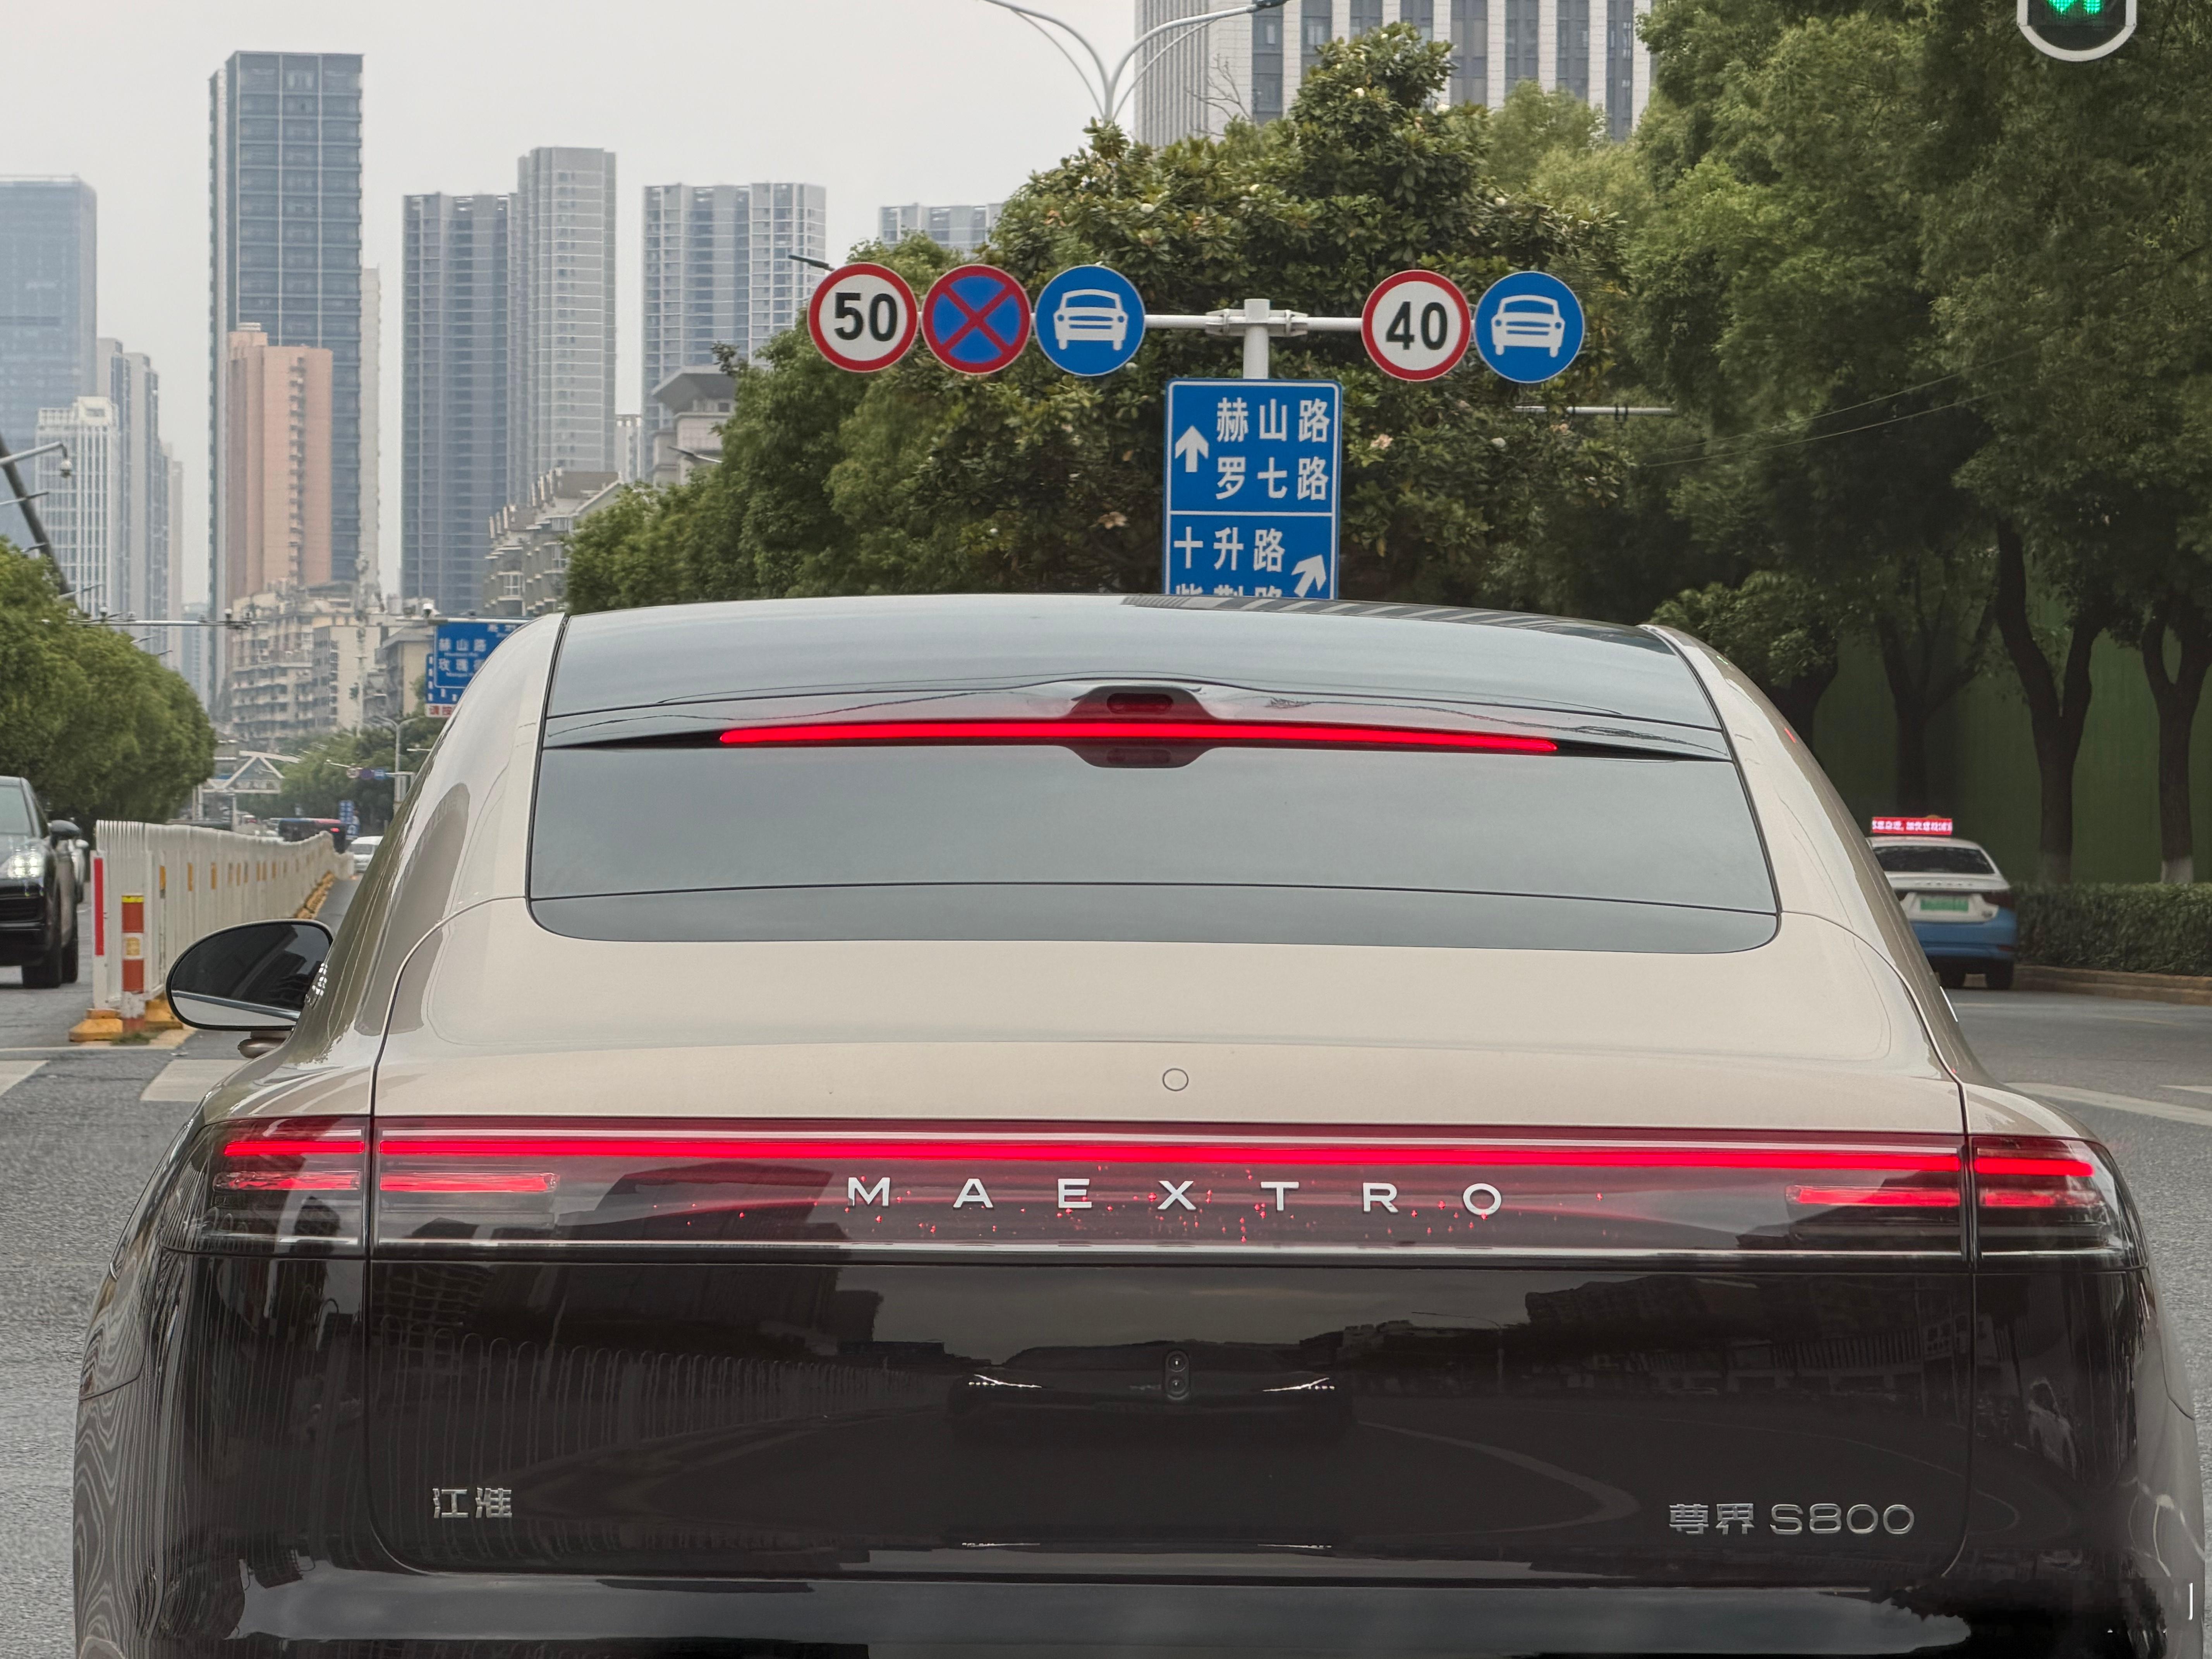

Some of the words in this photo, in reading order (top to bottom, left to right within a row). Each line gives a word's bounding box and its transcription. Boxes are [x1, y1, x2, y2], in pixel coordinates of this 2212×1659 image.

[835, 293, 898, 342] 50
[1386, 301, 1448, 350] 40
[1217, 397, 1330, 442] 赫山路
[1216, 456, 1329, 500] 罗七路
[1174, 526, 1285, 572] 十升路
[846, 1176, 1502, 1215] MAEXTRO
[432, 1487, 512, 1518] 江淮
[1669, 1503, 1755, 1535] 尊界
[1770, 1503, 1914, 1535] S800
